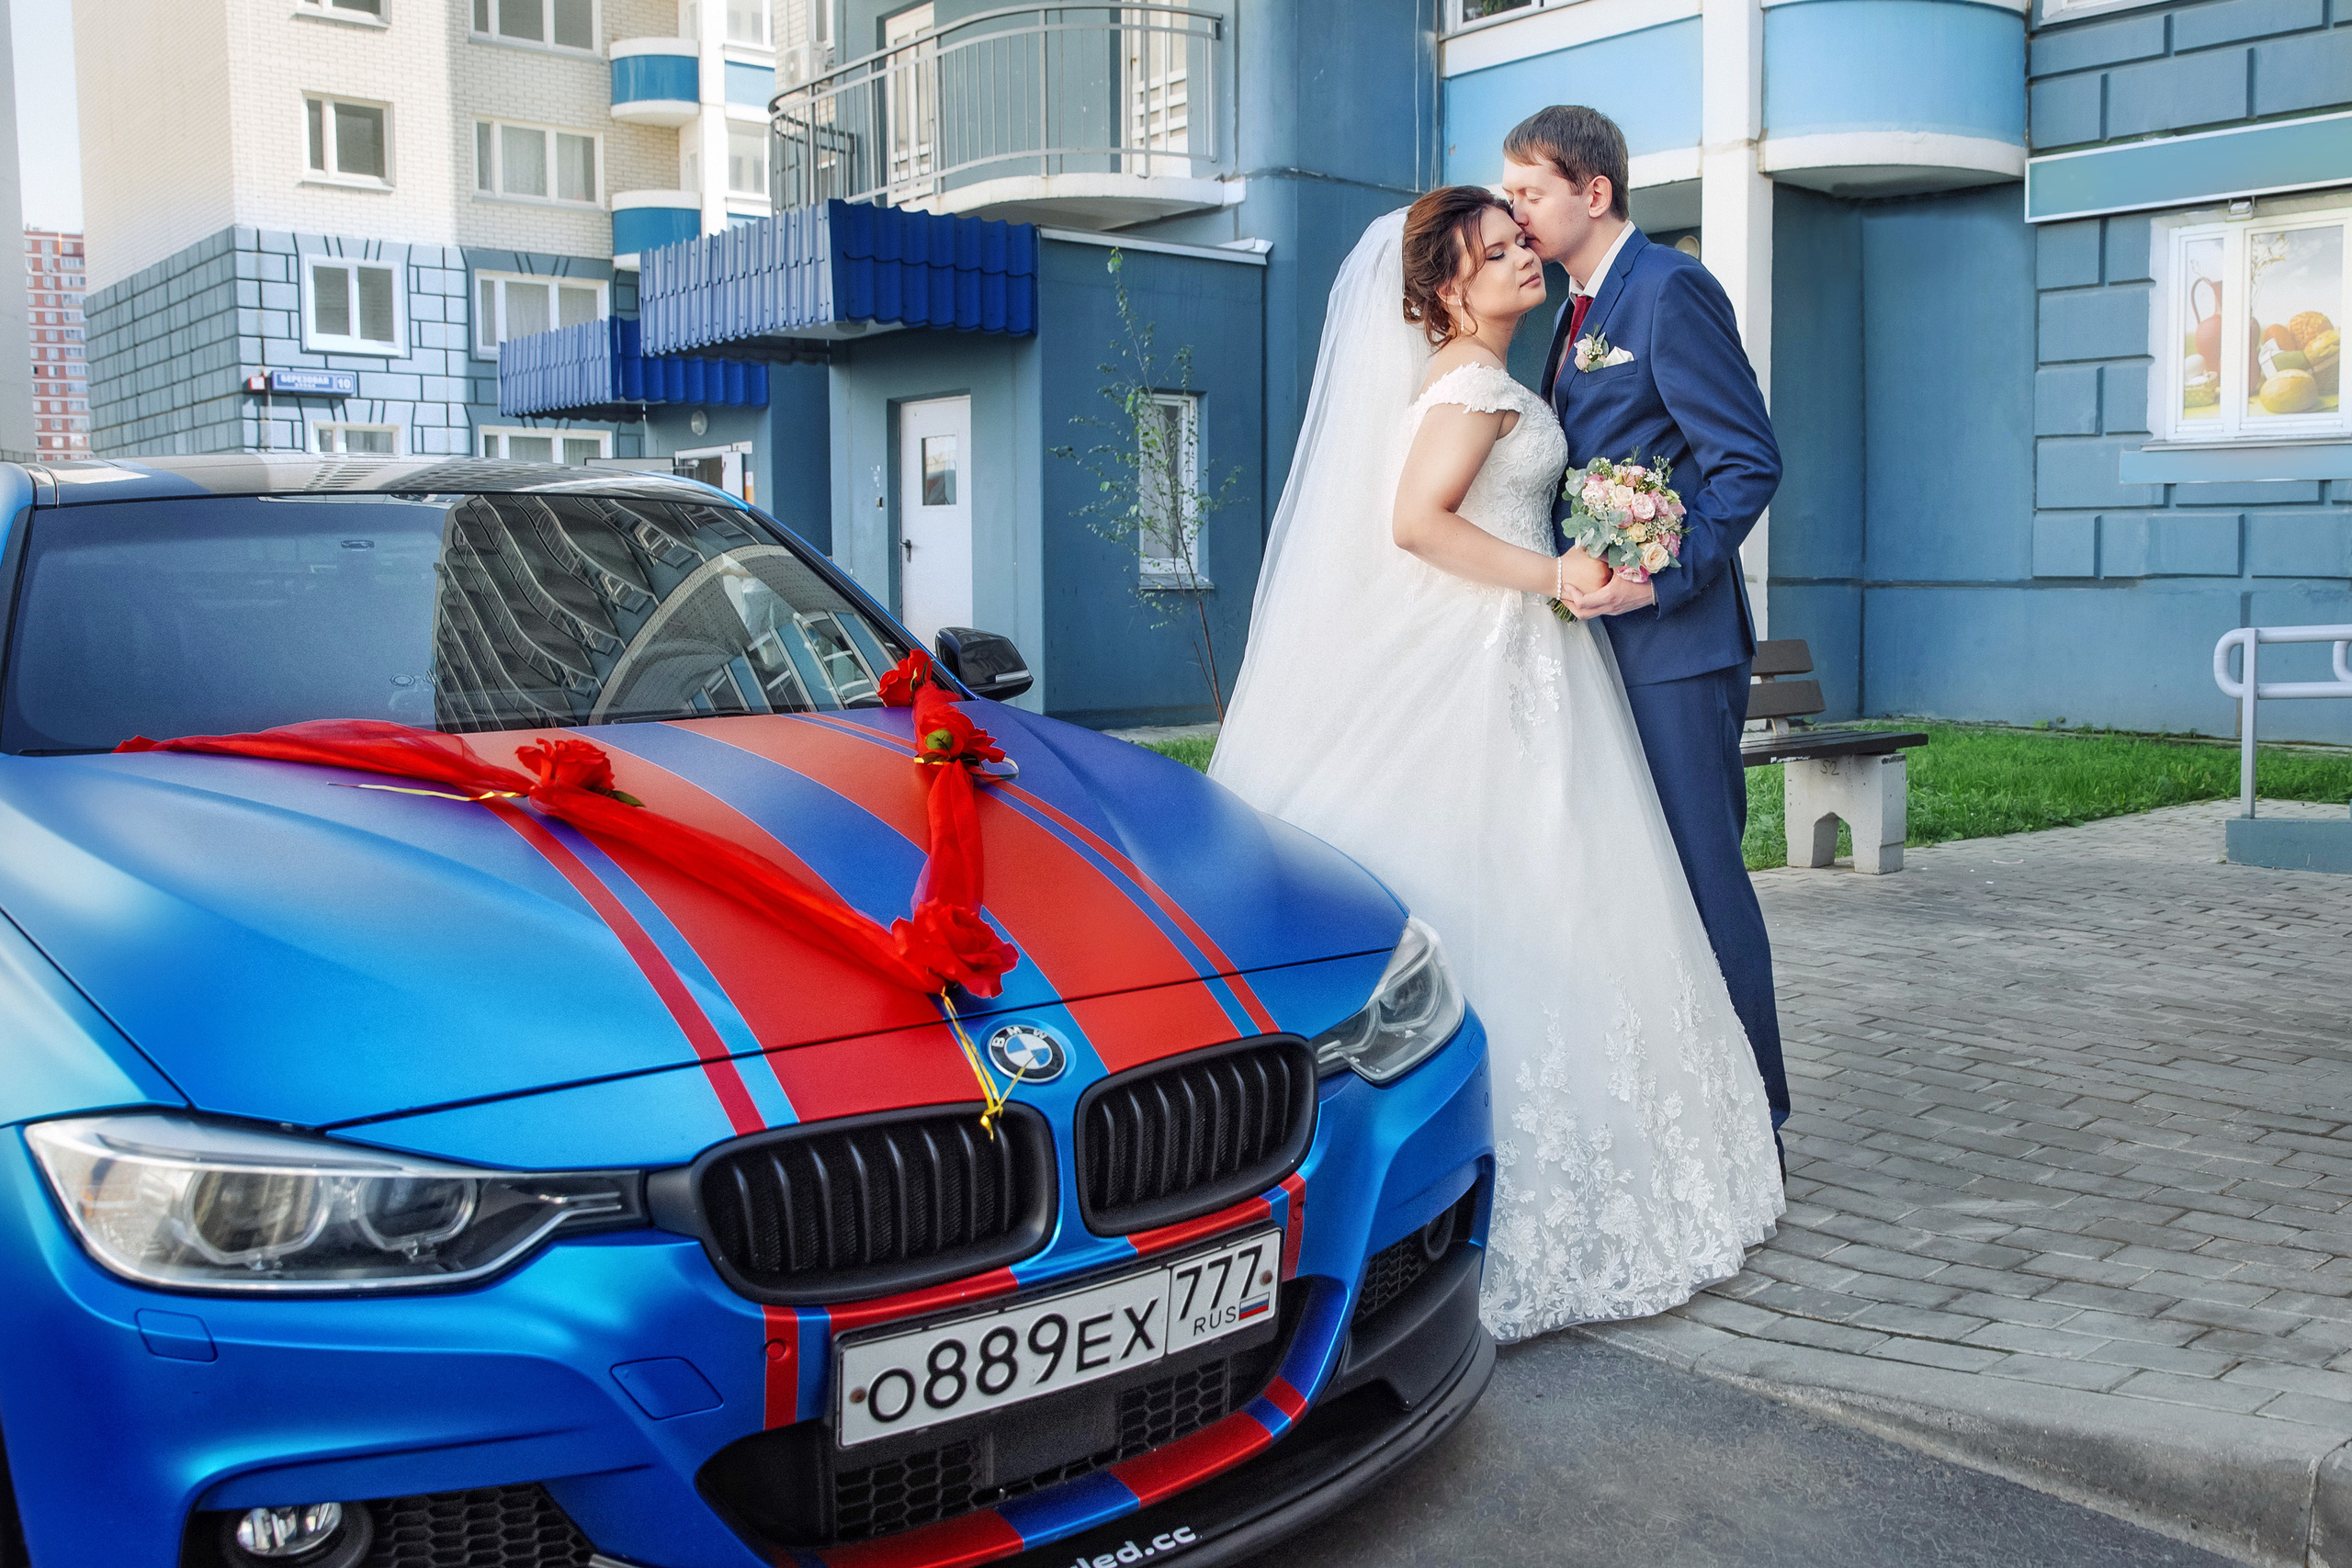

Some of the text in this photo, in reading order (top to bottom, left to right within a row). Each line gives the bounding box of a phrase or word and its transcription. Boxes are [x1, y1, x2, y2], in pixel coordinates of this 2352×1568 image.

[337, 378, 351, 389] 10
[991, 1025, 1048, 1048] BMW
[1176, 1244, 1263, 1322] 777
[1193, 1305, 1238, 1337] RUS
[1070, 1526, 1197, 1568] led.cc
